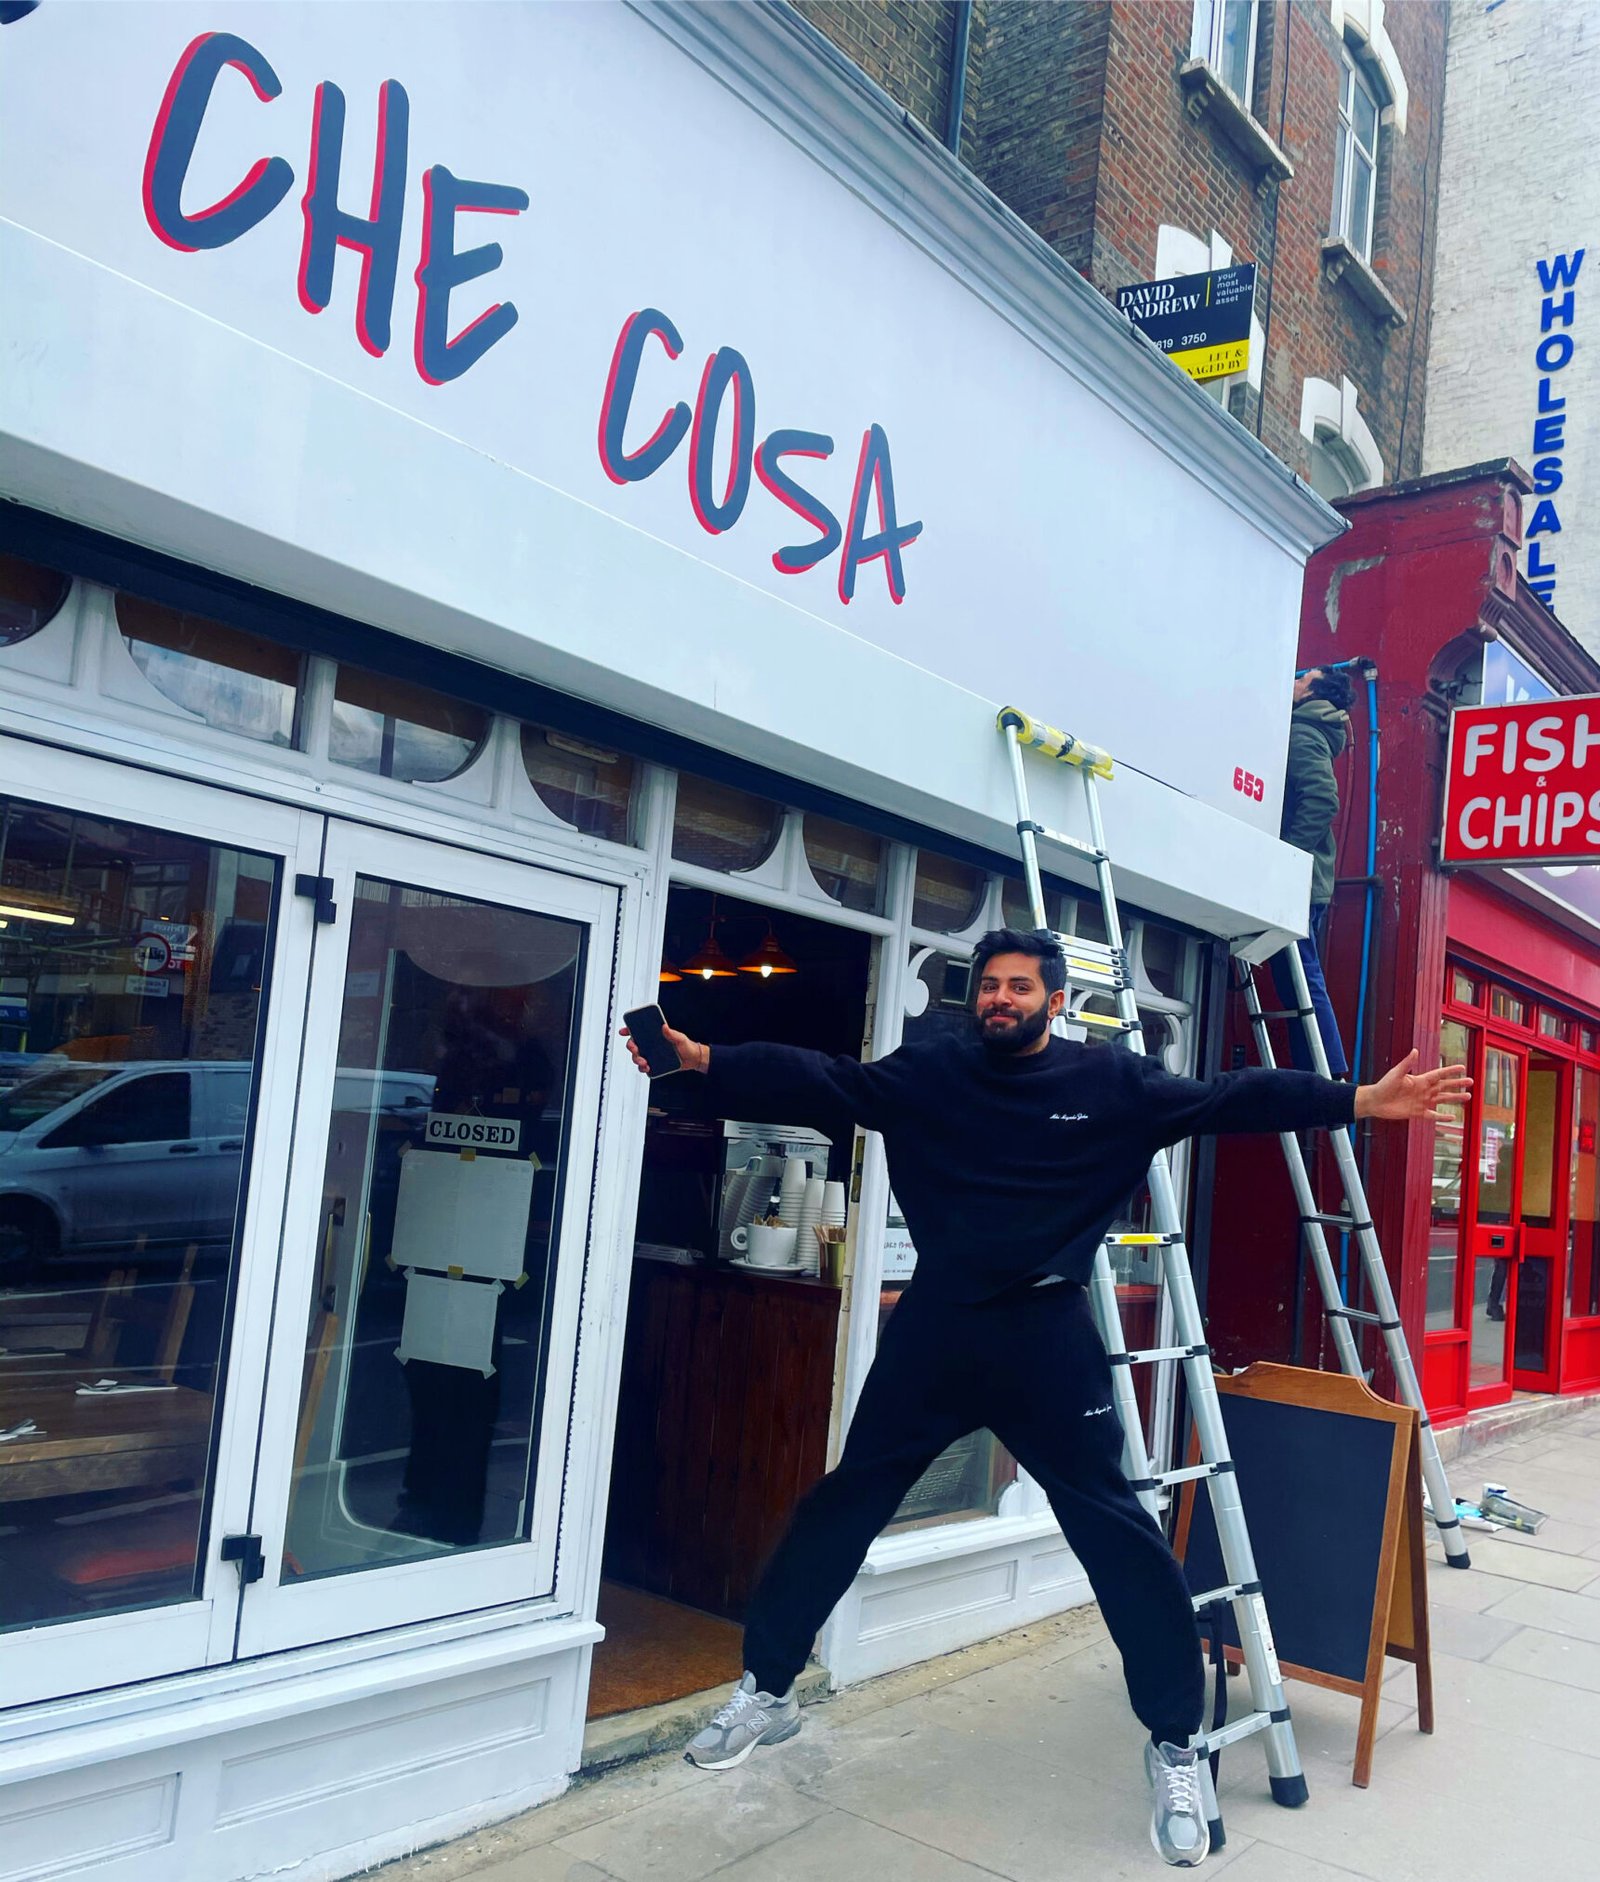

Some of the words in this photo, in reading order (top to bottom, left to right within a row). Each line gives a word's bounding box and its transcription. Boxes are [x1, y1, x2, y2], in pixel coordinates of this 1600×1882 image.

[1217, 272, 1237, 281] your
[1216, 284, 1252, 297] valuable
[1217, 280, 1239, 289] most
[1120, 284, 1175, 307] DAVID
[1215, 295, 1238, 305] asset
[1122, 294, 1200, 321] ANDREW
[142, 31, 530, 386] CHE
[598, 307, 923, 605] COSA
[1181, 332, 1207, 345] 3750
[1209, 350, 1230, 362] LET
[1234, 348, 1243, 358] &
[1187, 362, 1225, 376] NAGED
[1228, 359, 1242, 369] BY
[1463, 714, 1600, 777] FISH
[1233, 766, 1265, 802] 653
[1536, 775, 1547, 787] &
[429, 1120, 515, 1144] CLOSED
